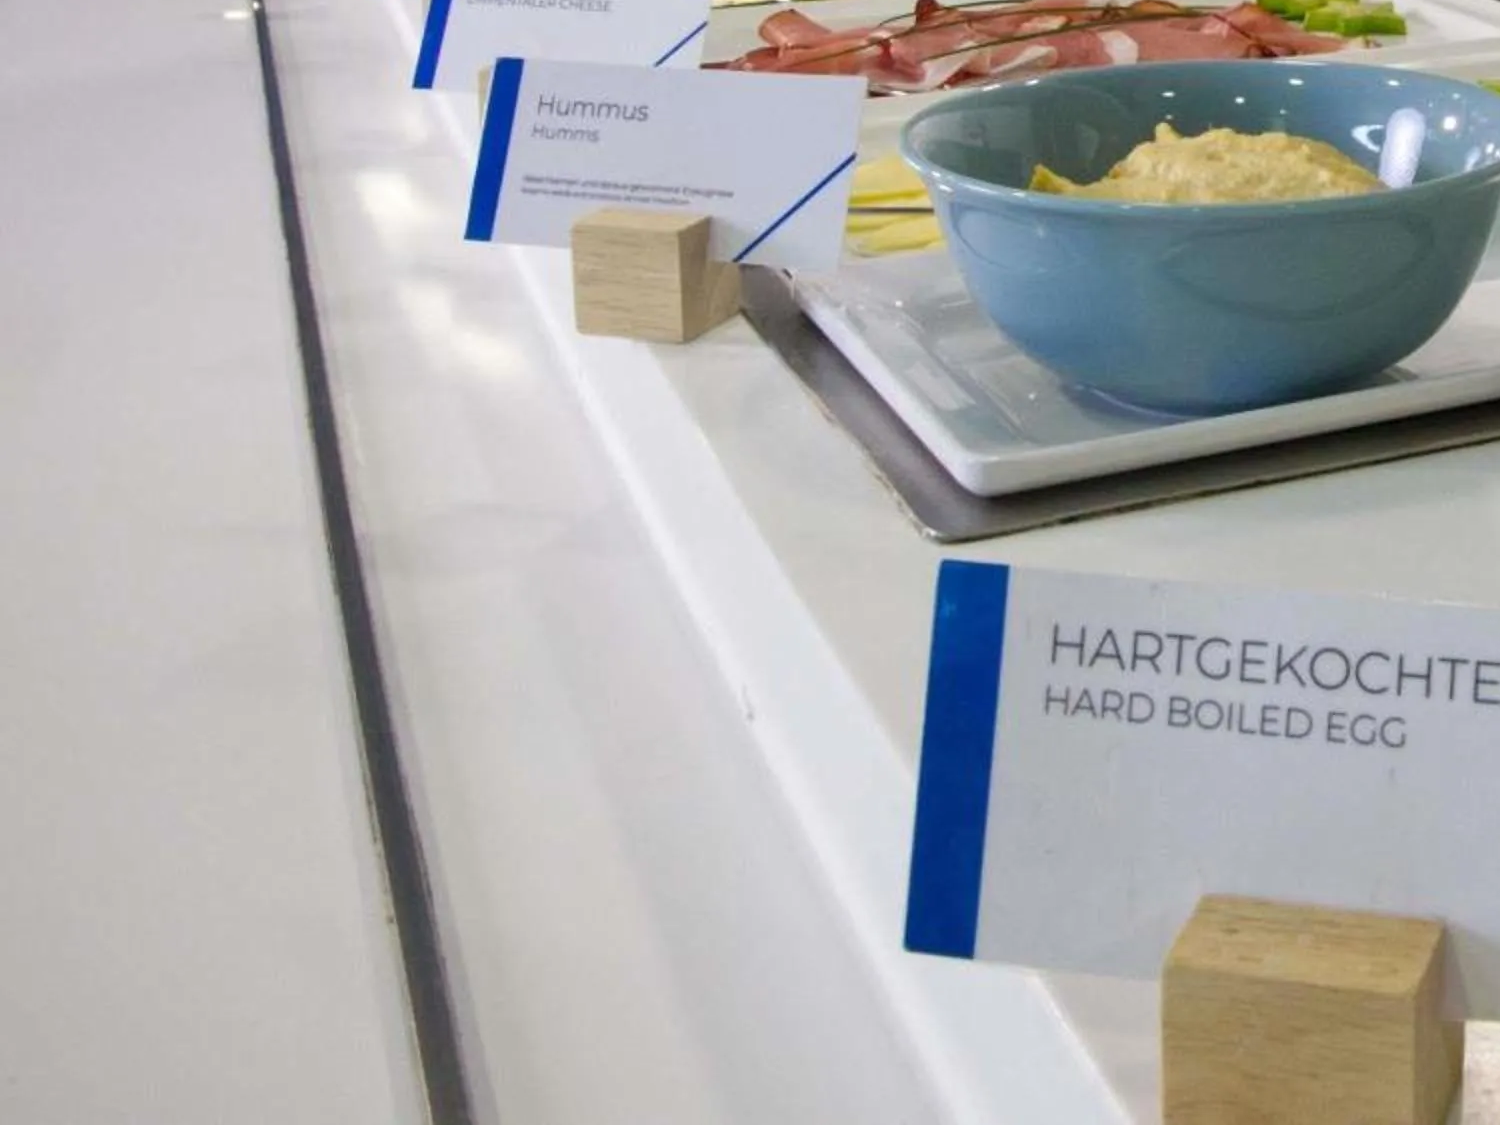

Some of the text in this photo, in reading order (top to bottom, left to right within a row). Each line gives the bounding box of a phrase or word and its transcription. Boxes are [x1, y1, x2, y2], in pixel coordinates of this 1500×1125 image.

[537, 94, 650, 122] Hummus
[531, 124, 601, 143] Humms
[1043, 685, 1408, 750] HARD BOILED EGG
